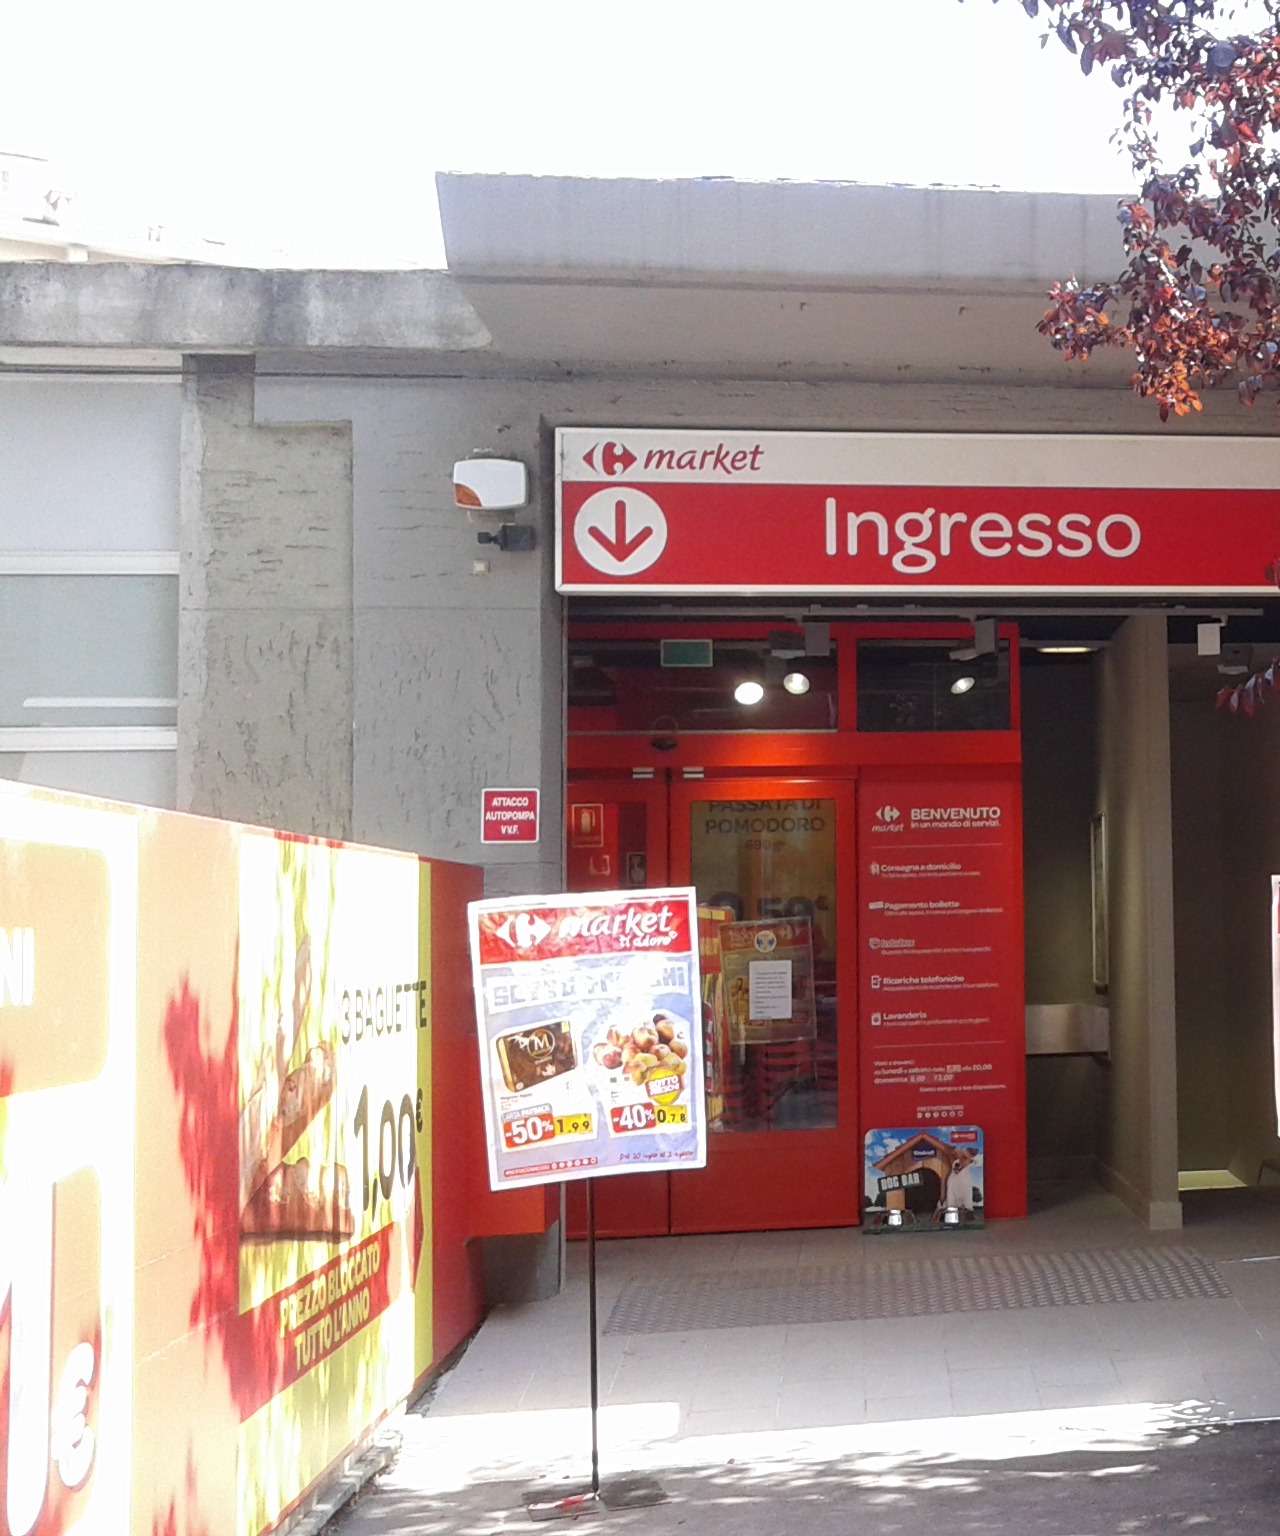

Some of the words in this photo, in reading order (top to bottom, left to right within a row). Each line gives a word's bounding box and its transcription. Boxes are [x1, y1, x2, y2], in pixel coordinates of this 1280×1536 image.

[644, 443, 764, 475] market
[825, 497, 1141, 574] Ingresso
[492, 797, 529, 807] ATTACCO
[708, 801, 797, 813] PASSATA
[803, 800, 820, 810] DI
[485, 811, 535, 820] AUTOPOMPA
[910, 807, 1001, 820] BENVENUTO
[932, 820, 961, 828] mondo
[963, 819, 970, 827] di
[706, 817, 824, 834] POMODORO
[872, 824, 904, 832] market
[559, 906, 672, 938] market
[356, 980, 427, 1041] BAGUETTE
[613, 1105, 655, 1129] -40%
[505, 1116, 554, 1144] -50%
[881, 1178, 899, 1191] DOG
[901, 1173, 920, 1186] BAR
[280, 1273, 326, 1338] PREZZO
[327, 1240, 380, 1305] BLOCCATO
[294, 1314, 333, 1371] TUTTO
[333, 1287, 370, 1342] L'ANNO
